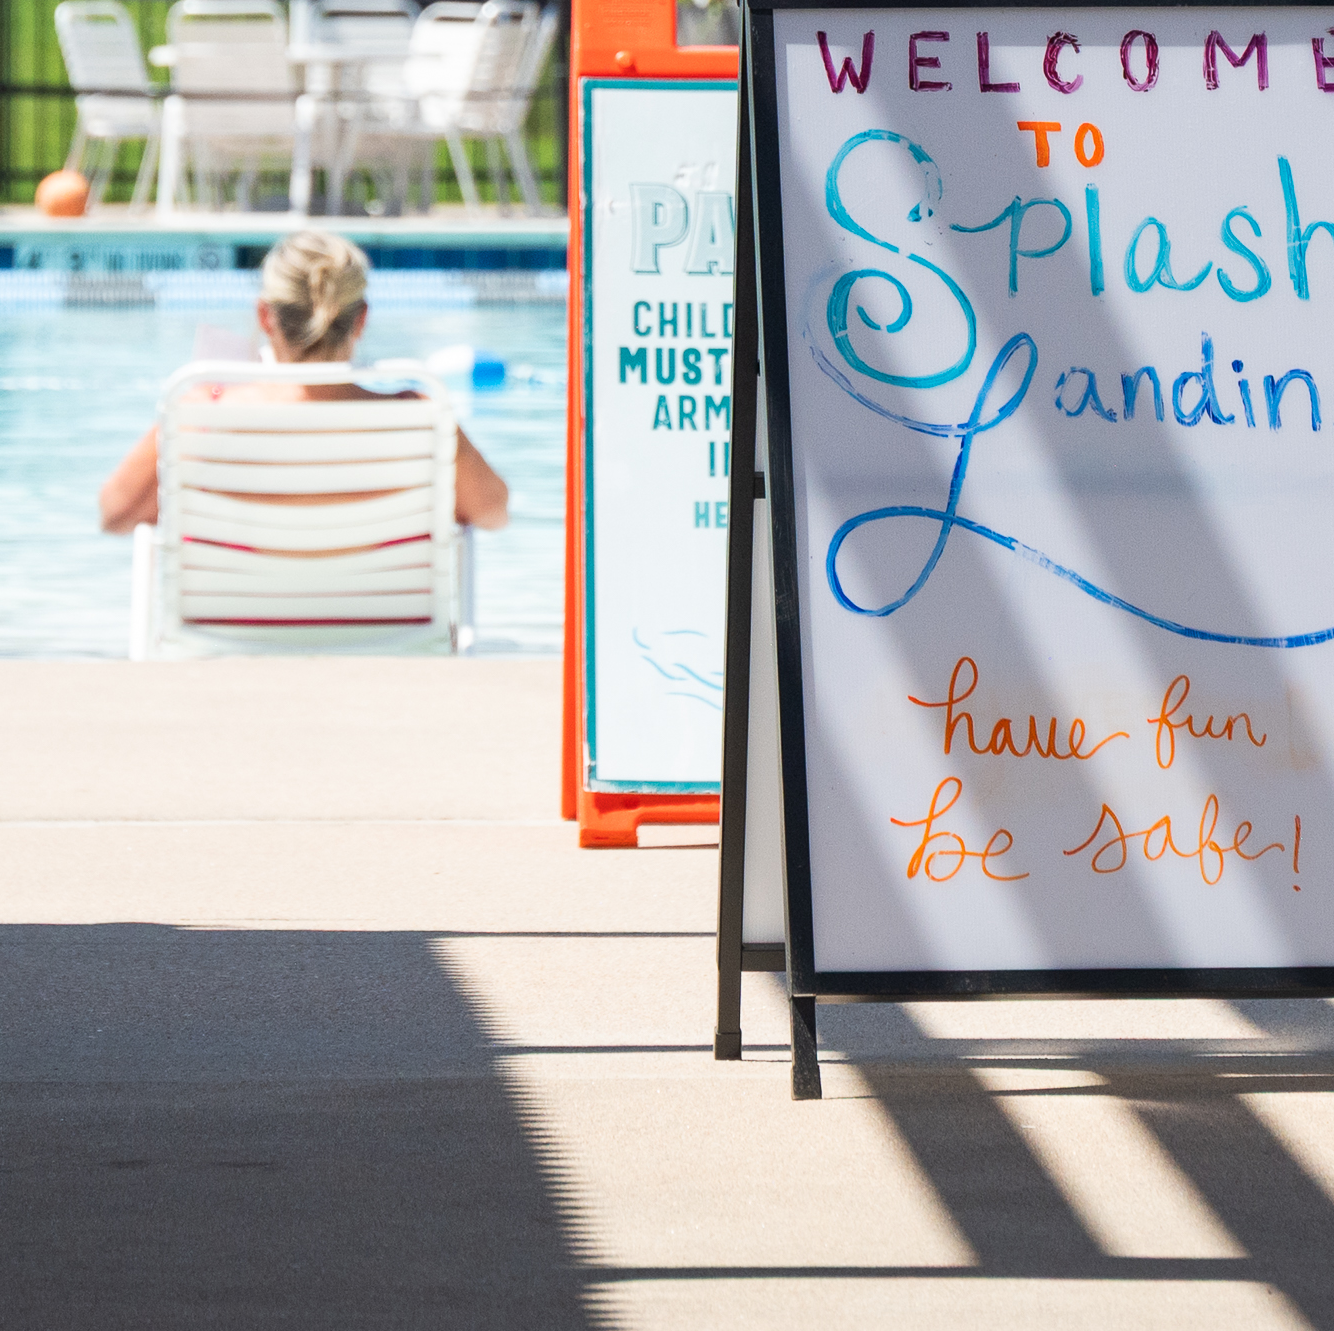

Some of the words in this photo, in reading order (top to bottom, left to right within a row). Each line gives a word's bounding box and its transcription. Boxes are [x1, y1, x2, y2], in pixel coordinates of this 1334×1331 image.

[1016, 120, 1106, 169] TO
[619, 346, 729, 386] MUST
[907, 655, 1130, 761] have
[1146, 674, 1268, 771] fun
[890, 775, 1030, 883] be
[1062, 792, 1303, 892] safe!
